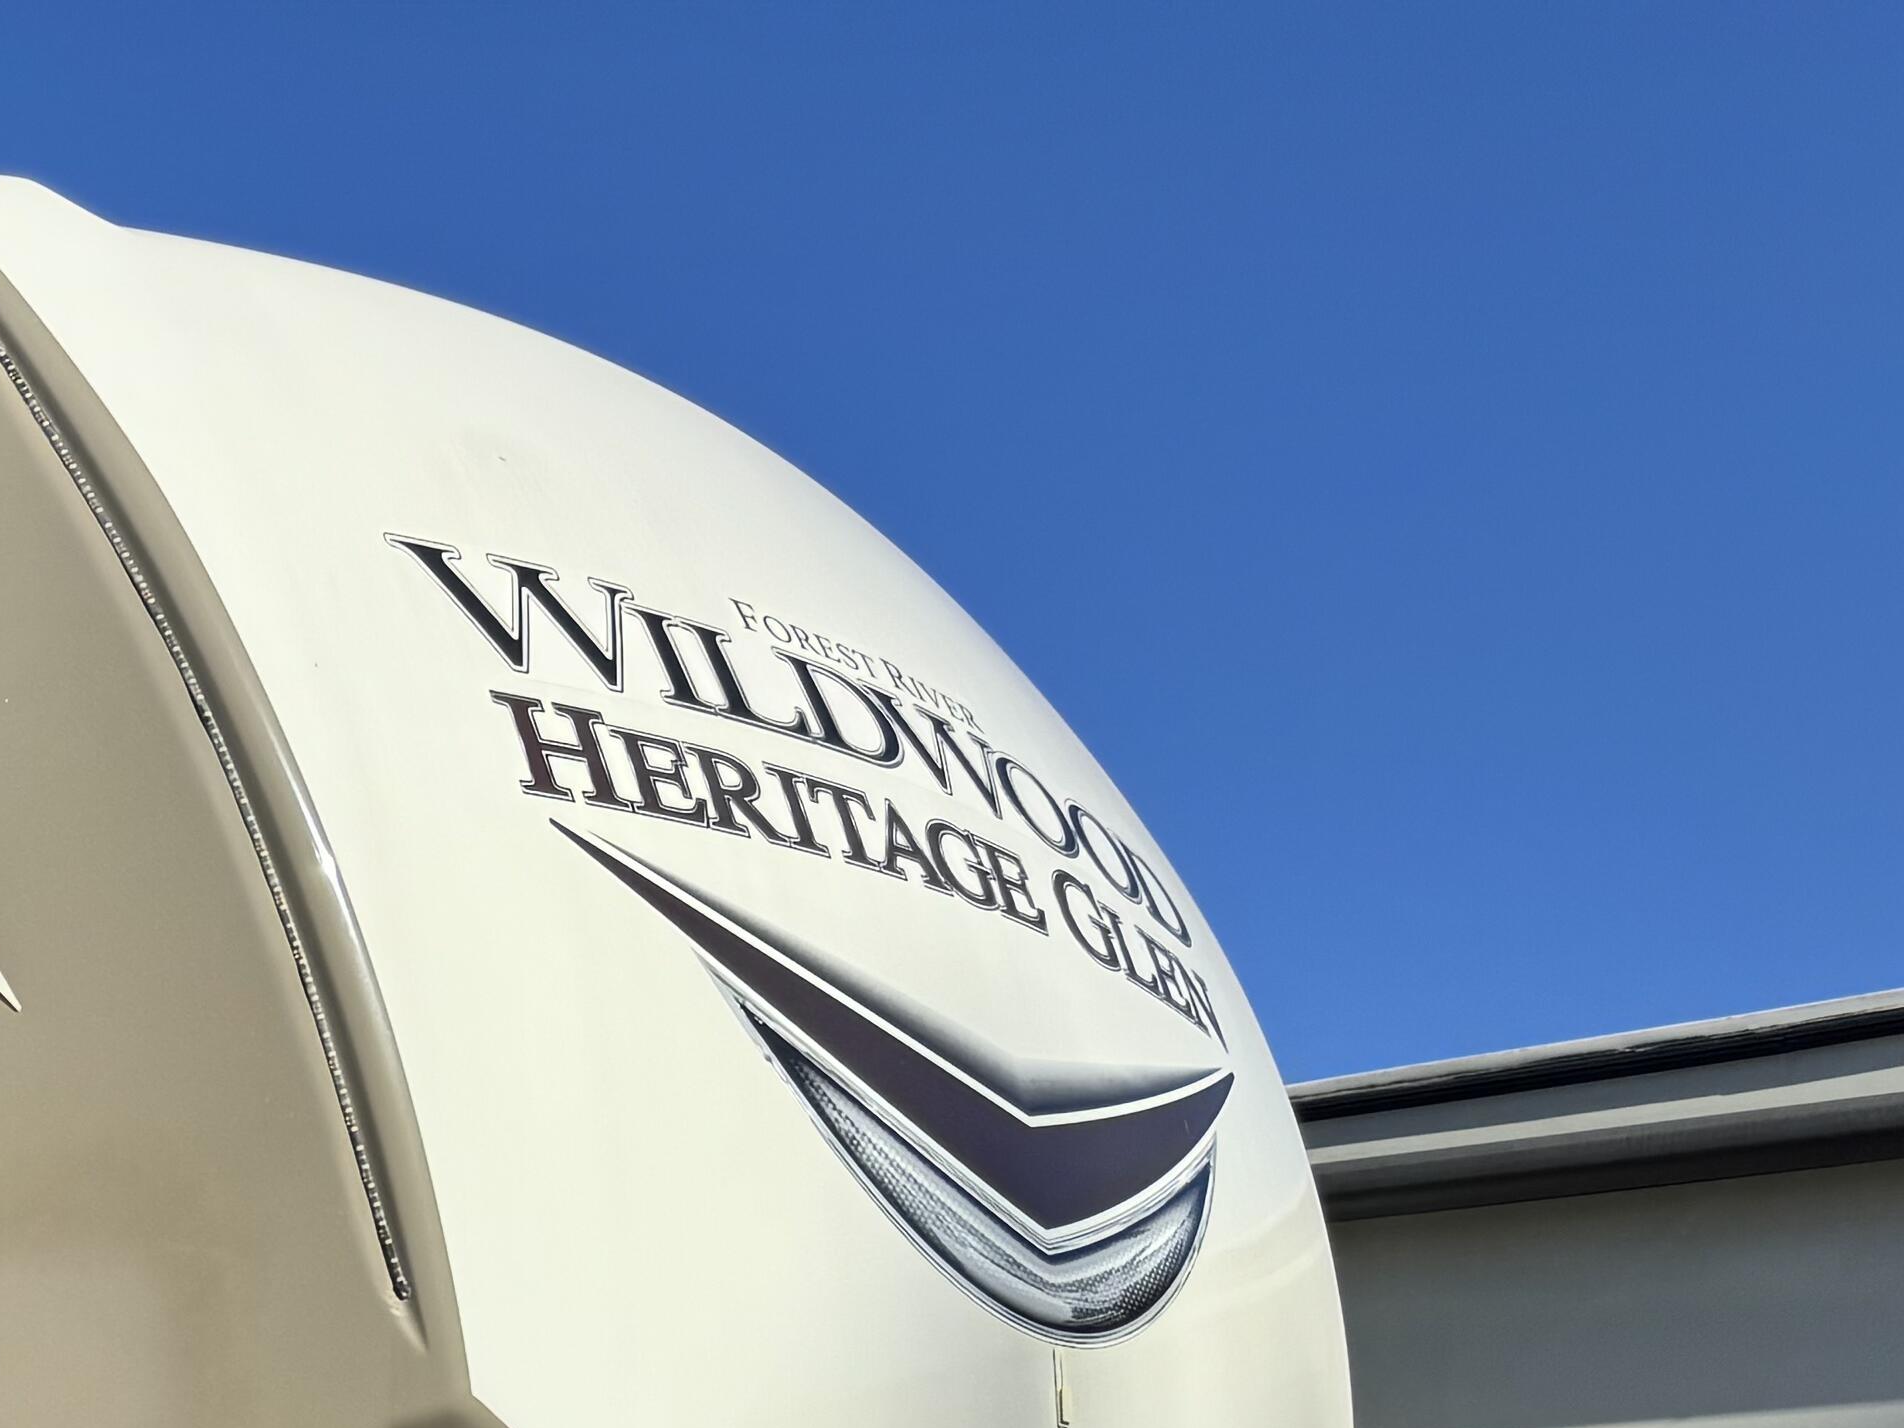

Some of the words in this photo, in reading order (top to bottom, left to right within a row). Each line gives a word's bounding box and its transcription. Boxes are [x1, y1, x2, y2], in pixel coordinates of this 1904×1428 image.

[383, 532, 1193, 948] WILDWOOD
[728, 597, 878, 679] FOREST
[879, 657, 985, 734] RIVER
[489, 689, 1049, 937] HERITAGE
[1051, 868, 1229, 1054] GLEN
